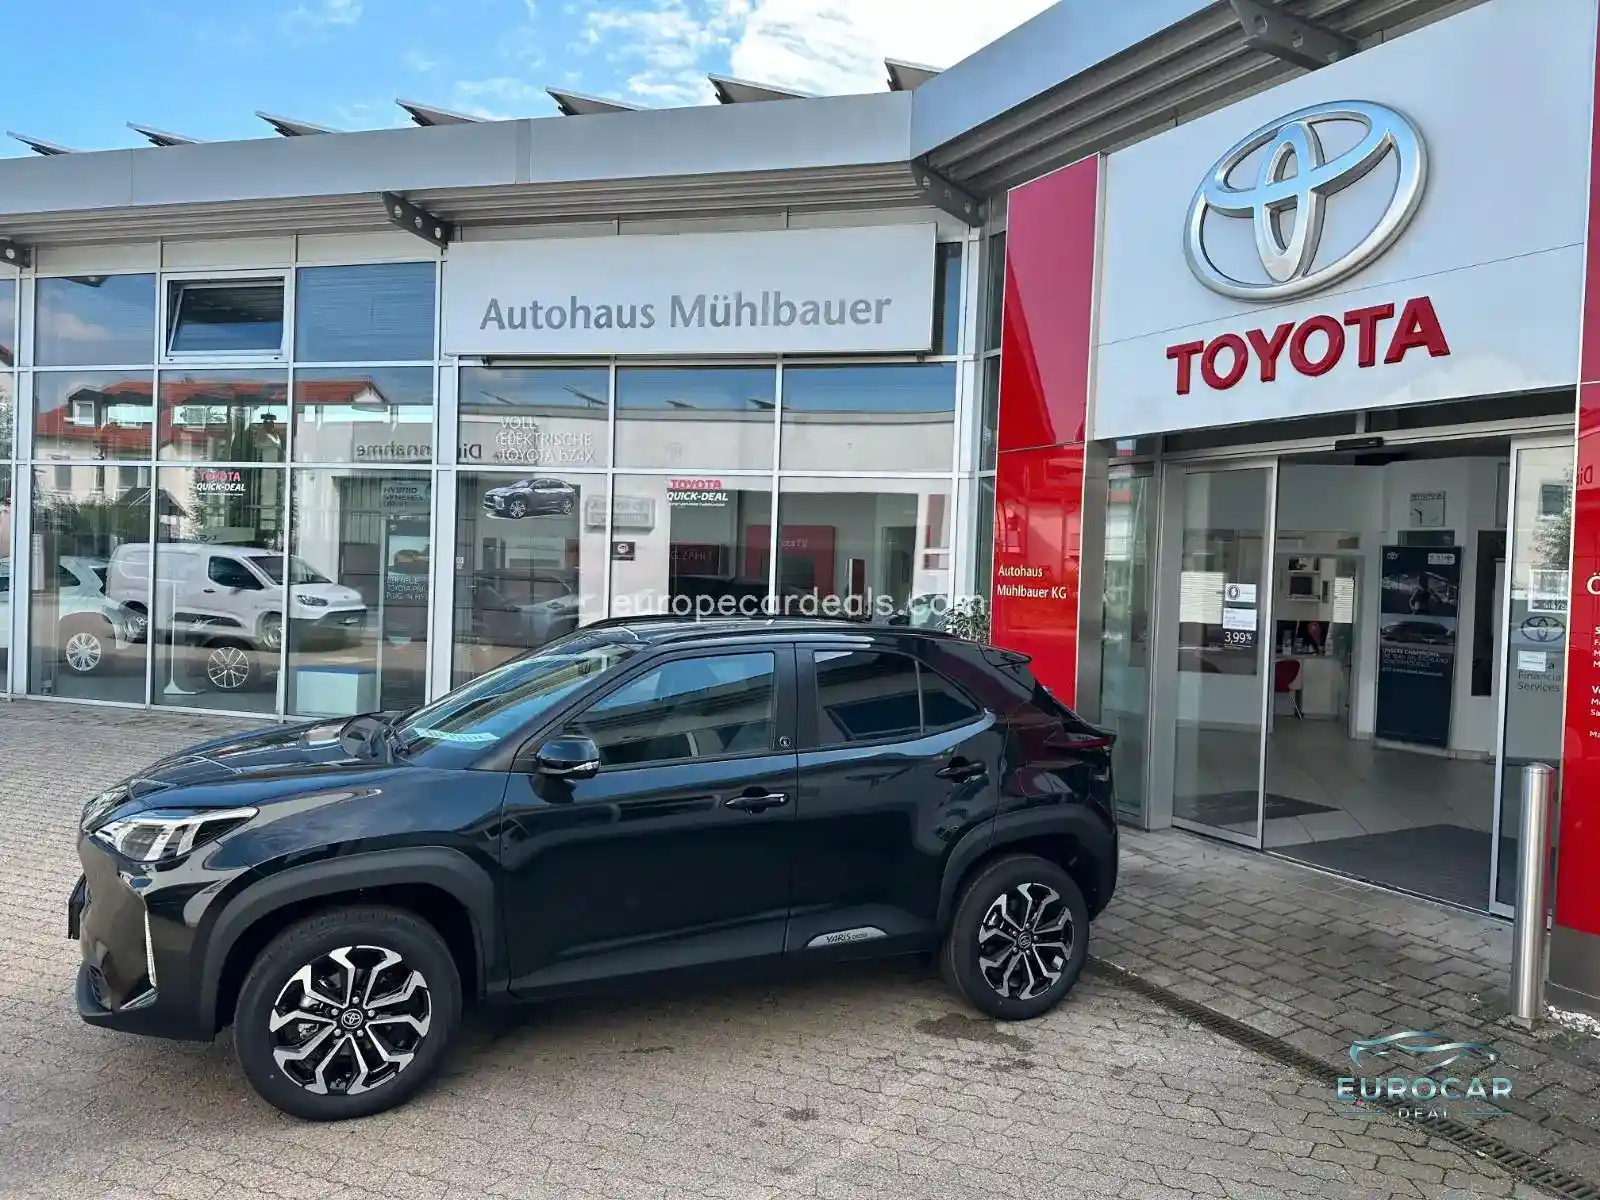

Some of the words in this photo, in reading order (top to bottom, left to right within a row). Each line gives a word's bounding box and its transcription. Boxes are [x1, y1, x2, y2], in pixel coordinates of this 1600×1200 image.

[480, 295, 655, 331] Autohaus
[669, 290, 892, 328] Mühlbauer
[1166, 296, 1450, 395] TOYOTA
[196, 483, 246, 491] QUICK-DEAL
[671, 480, 722, 489] TOYOTA
[666, 491, 729, 502] QUICK-DEAL
[997, 564, 1043, 577] Autohaus
[997, 584, 1049, 598] Mühlbauer
[1051, 586, 1067, 599] KG
[1518, 671, 1562, 682] Financia
[1518, 682, 1561, 693] Services
